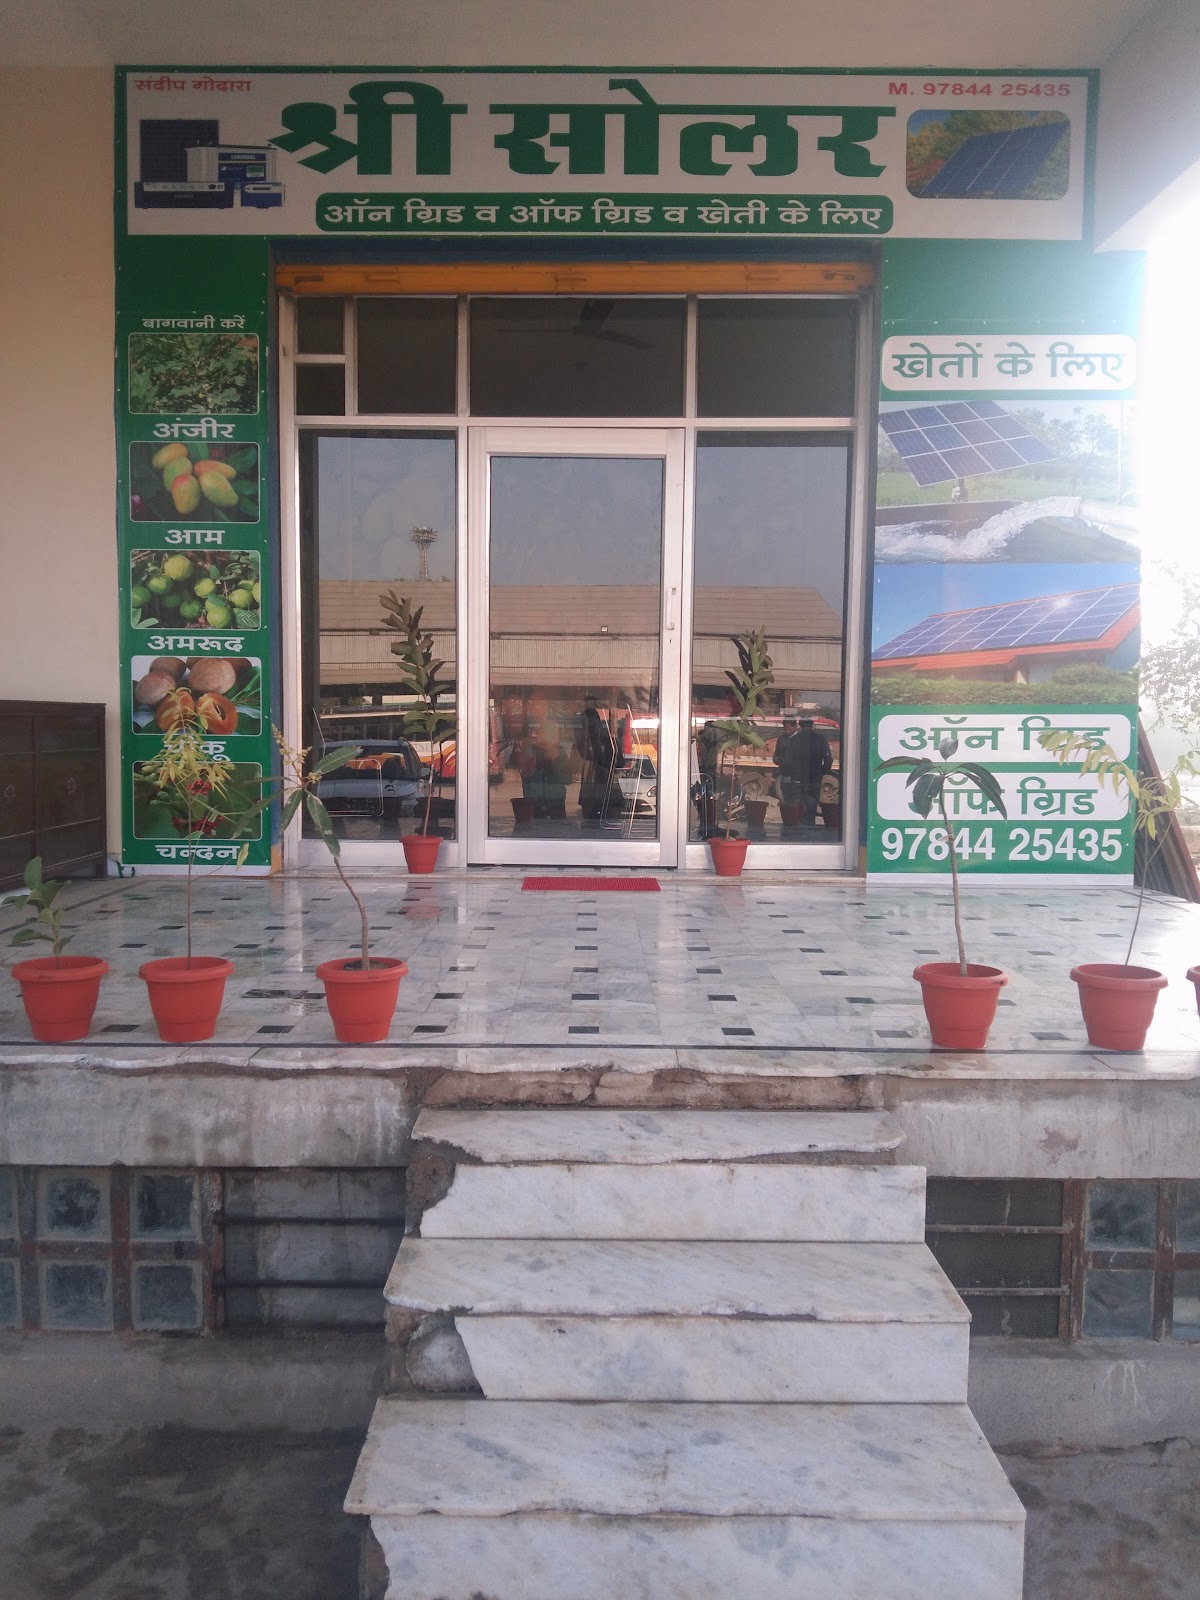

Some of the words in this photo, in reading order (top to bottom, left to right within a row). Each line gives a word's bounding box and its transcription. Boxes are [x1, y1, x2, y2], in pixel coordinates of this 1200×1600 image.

[135, 77, 187, 92] संदीप
[192, 77, 252, 92] गोदारा
[889, 82, 915, 96] M.
[923, 82, 992, 96] 97844
[1000, 82, 1071, 97] 25435
[267, 81, 468, 176] श्री
[489, 78, 897, 178] सोलर
[324, 199, 393, 224] ऑन
[404, 198, 465, 224] ग्रिड
[474, 205, 499, 224] व
[509, 199, 583, 224] ऑफ
[592, 197, 654, 225] ग्रिड
[662, 206, 689, 224] व
[697, 199, 768, 224] खेती
[778, 199, 810, 225] के
[819, 198, 883, 229] लिए
[142, 314, 215, 329] बागवानी
[221, 315, 246, 329] करें
[891, 342, 983, 379] खेतों
[994, 342, 1036, 378] के
[1045, 342, 1127, 383] लिए
[152, 416, 236, 439] अंजीर
[164, 528, 225, 545] आम
[147, 635, 245, 652] अमरूद
[899, 716, 1005, 752] ऑन
[1016, 776, 1099, 816] ग्रिड
[156, 844, 241, 861] चन्दन
[881, 827, 996, 861] 97844
[1008, 827, 1123, 862] 25435
